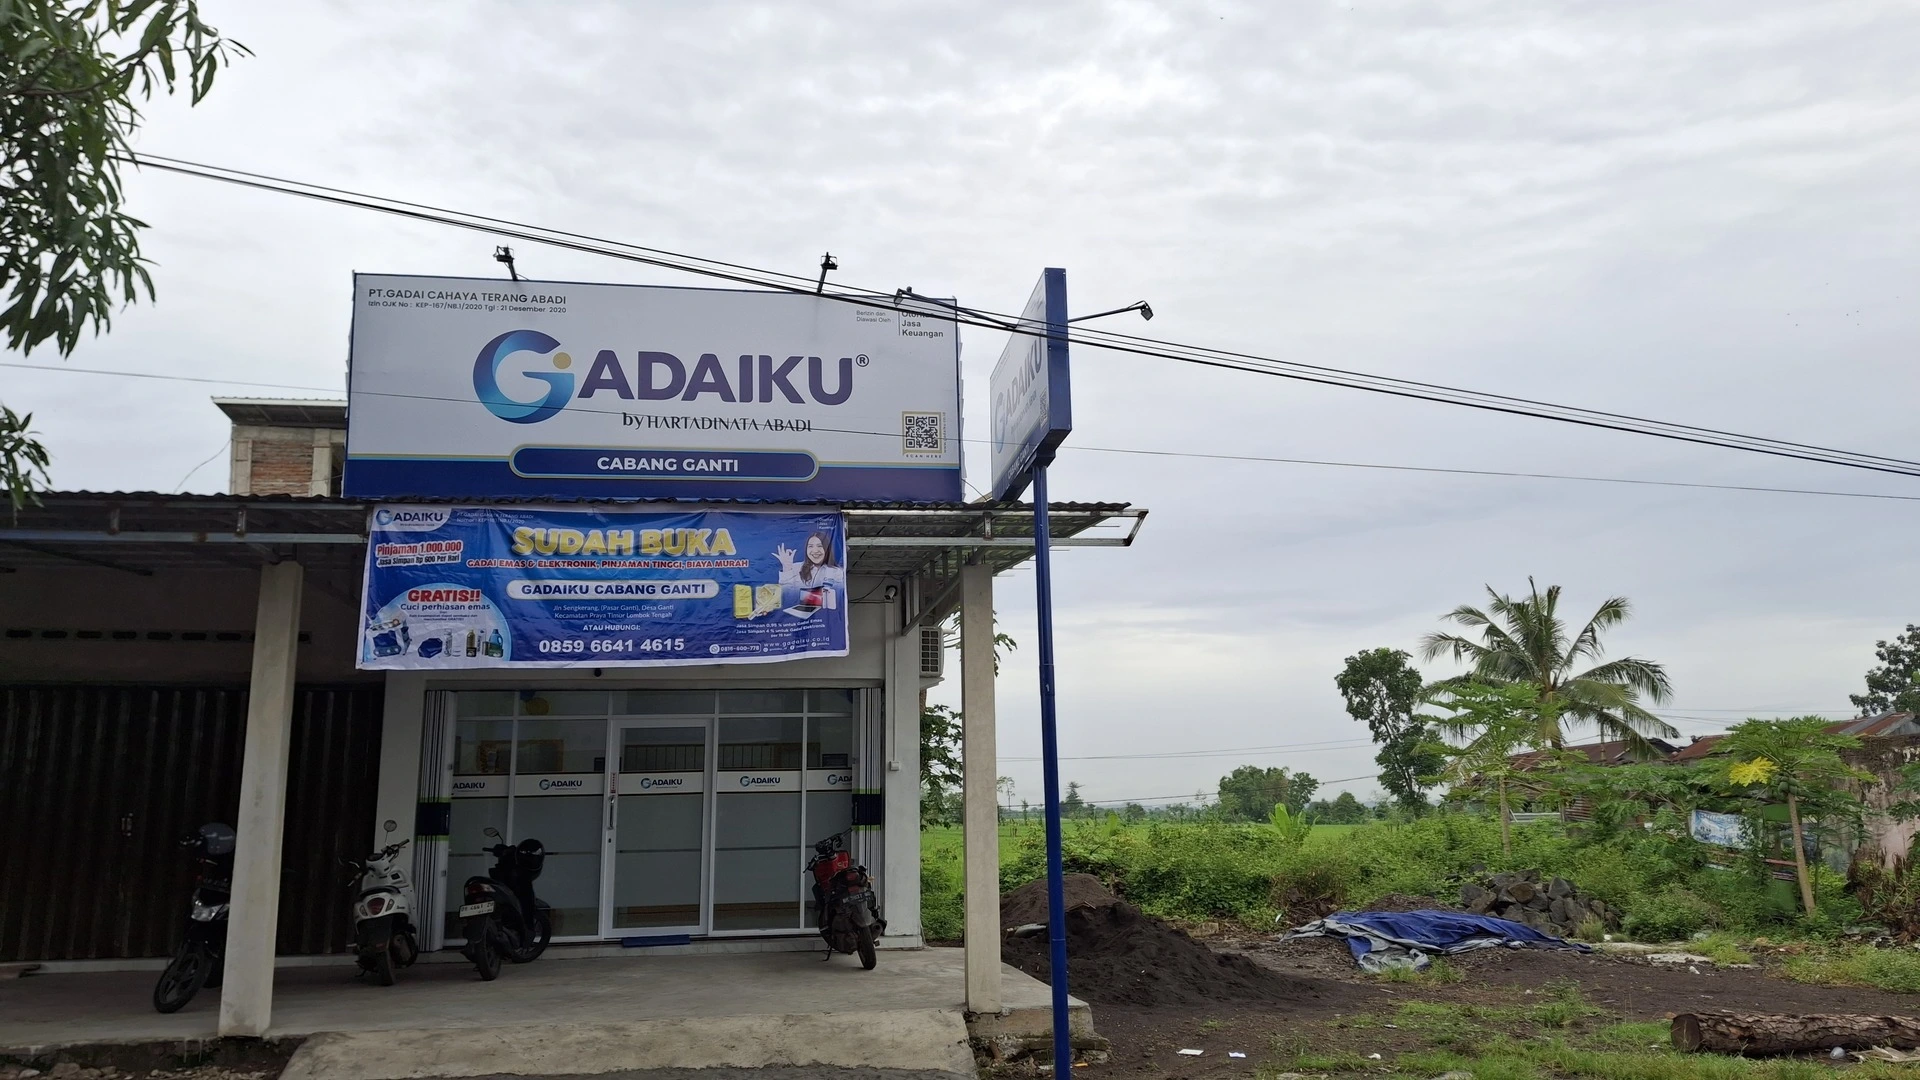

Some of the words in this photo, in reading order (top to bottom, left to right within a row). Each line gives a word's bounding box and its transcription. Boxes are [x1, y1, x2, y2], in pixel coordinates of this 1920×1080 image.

[369, 288, 424, 299] PT.GADAI
[427, 291, 477, 301] CAHAYA
[481, 293, 527, 303] TERANG
[531, 295, 566, 304] ABADI
[902, 329, 944, 338] Keuangan
[622, 412, 644, 430] by
[647, 415, 760, 431] HARTADINATA
[762, 418, 812, 432] ABADI
[597, 457, 677, 471] CABANG
[682, 458, 739, 472] GANTI
[512, 527, 634, 556] SUDAH
[639, 528, 737, 556] BUKA
[376, 543, 418, 557] Pinjaman
[420, 541, 462, 554] 1.000.000
[377, 558, 392, 566] Jasa
[392, 557, 414, 565] Simpan
[467, 560, 496, 568] GADAI
[499, 560, 526, 568] EMAS
[527, 560, 535, 568] &
[538, 560, 600, 569] ELEKTRONIK,
[601, 560, 650, 568] PINJAMAN
[652, 561, 685, 569] TINGGI,
[714, 560, 748, 568] MURAH
[521, 584, 589, 595] GADAIKU
[594, 584, 656, 595] CABANG
[660, 584, 705, 594] GANTI
[407, 590, 480, 602] GRATIS!!
[400, 603, 419, 611] Cuci
[421, 603, 466, 611] perhiasan
[589, 612, 607, 620] Praya
[538, 639, 585, 653] 0859
[590, 639, 634, 653] 6641
[640, 638, 685, 651] 4615
[452, 782, 486, 790] ADAIKU
[539, 778, 583, 790] GADAIKU
[640, 777, 683, 789] GADAIKU
[739, 775, 781, 787] GADAIKU
